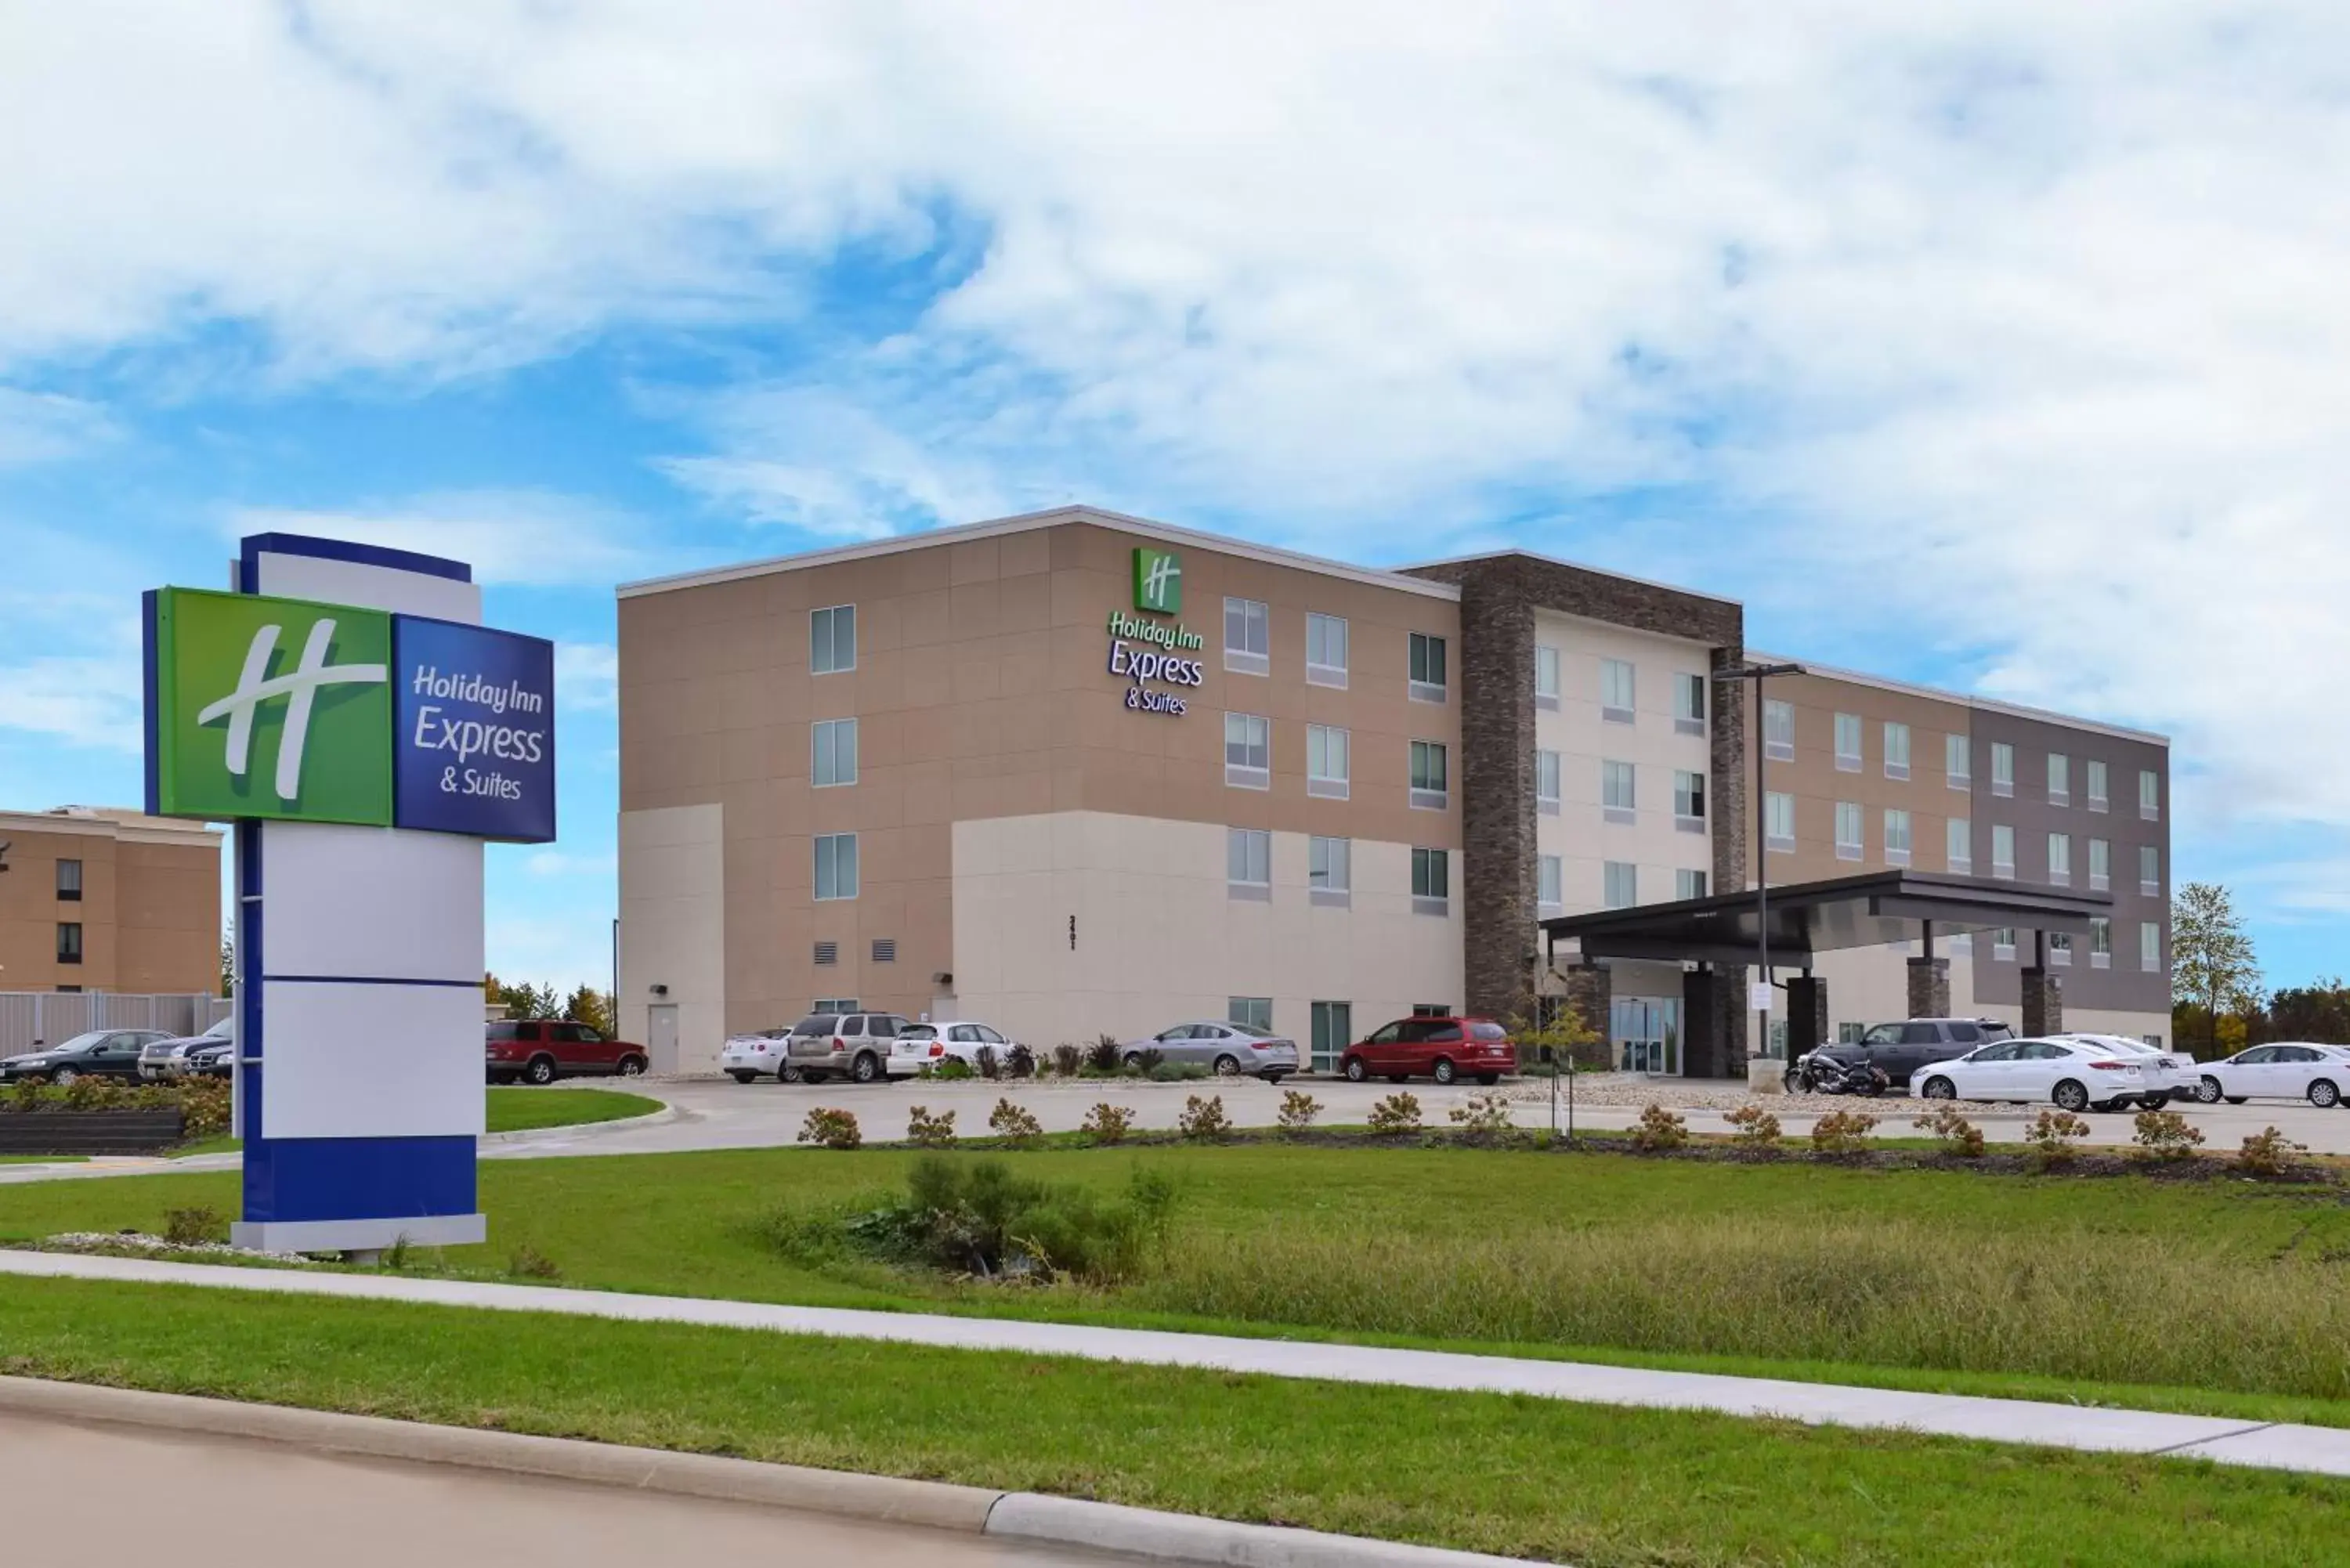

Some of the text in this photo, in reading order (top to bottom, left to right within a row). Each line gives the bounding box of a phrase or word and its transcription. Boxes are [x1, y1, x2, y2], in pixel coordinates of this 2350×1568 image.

[1111, 610, 1203, 651] Holiday Inn
[1111, 639, 1204, 686] Express
[413, 664, 542, 714] Holiday Inn
[1126, 686, 1188, 716] & Suites
[414, 705, 543, 764] Express
[439, 765, 522, 800] & Suites
